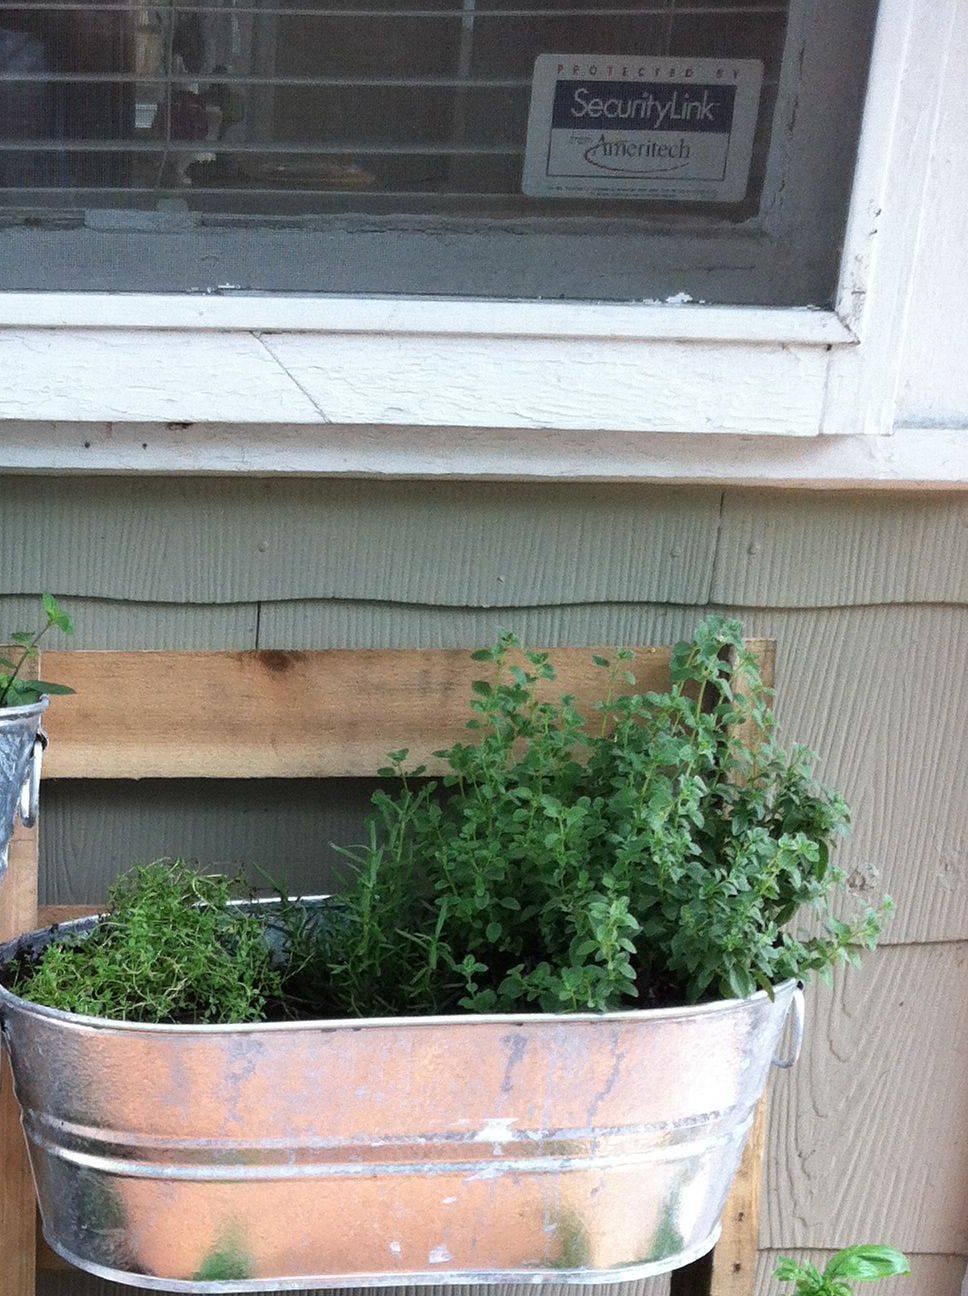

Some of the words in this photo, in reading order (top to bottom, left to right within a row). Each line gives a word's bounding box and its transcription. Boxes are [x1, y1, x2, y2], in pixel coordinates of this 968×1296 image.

[557, 64, 694, 78] PROTECTED
[571, 88, 714, 129] SecurityLink
[591, 134, 690, 159] Ameritech
